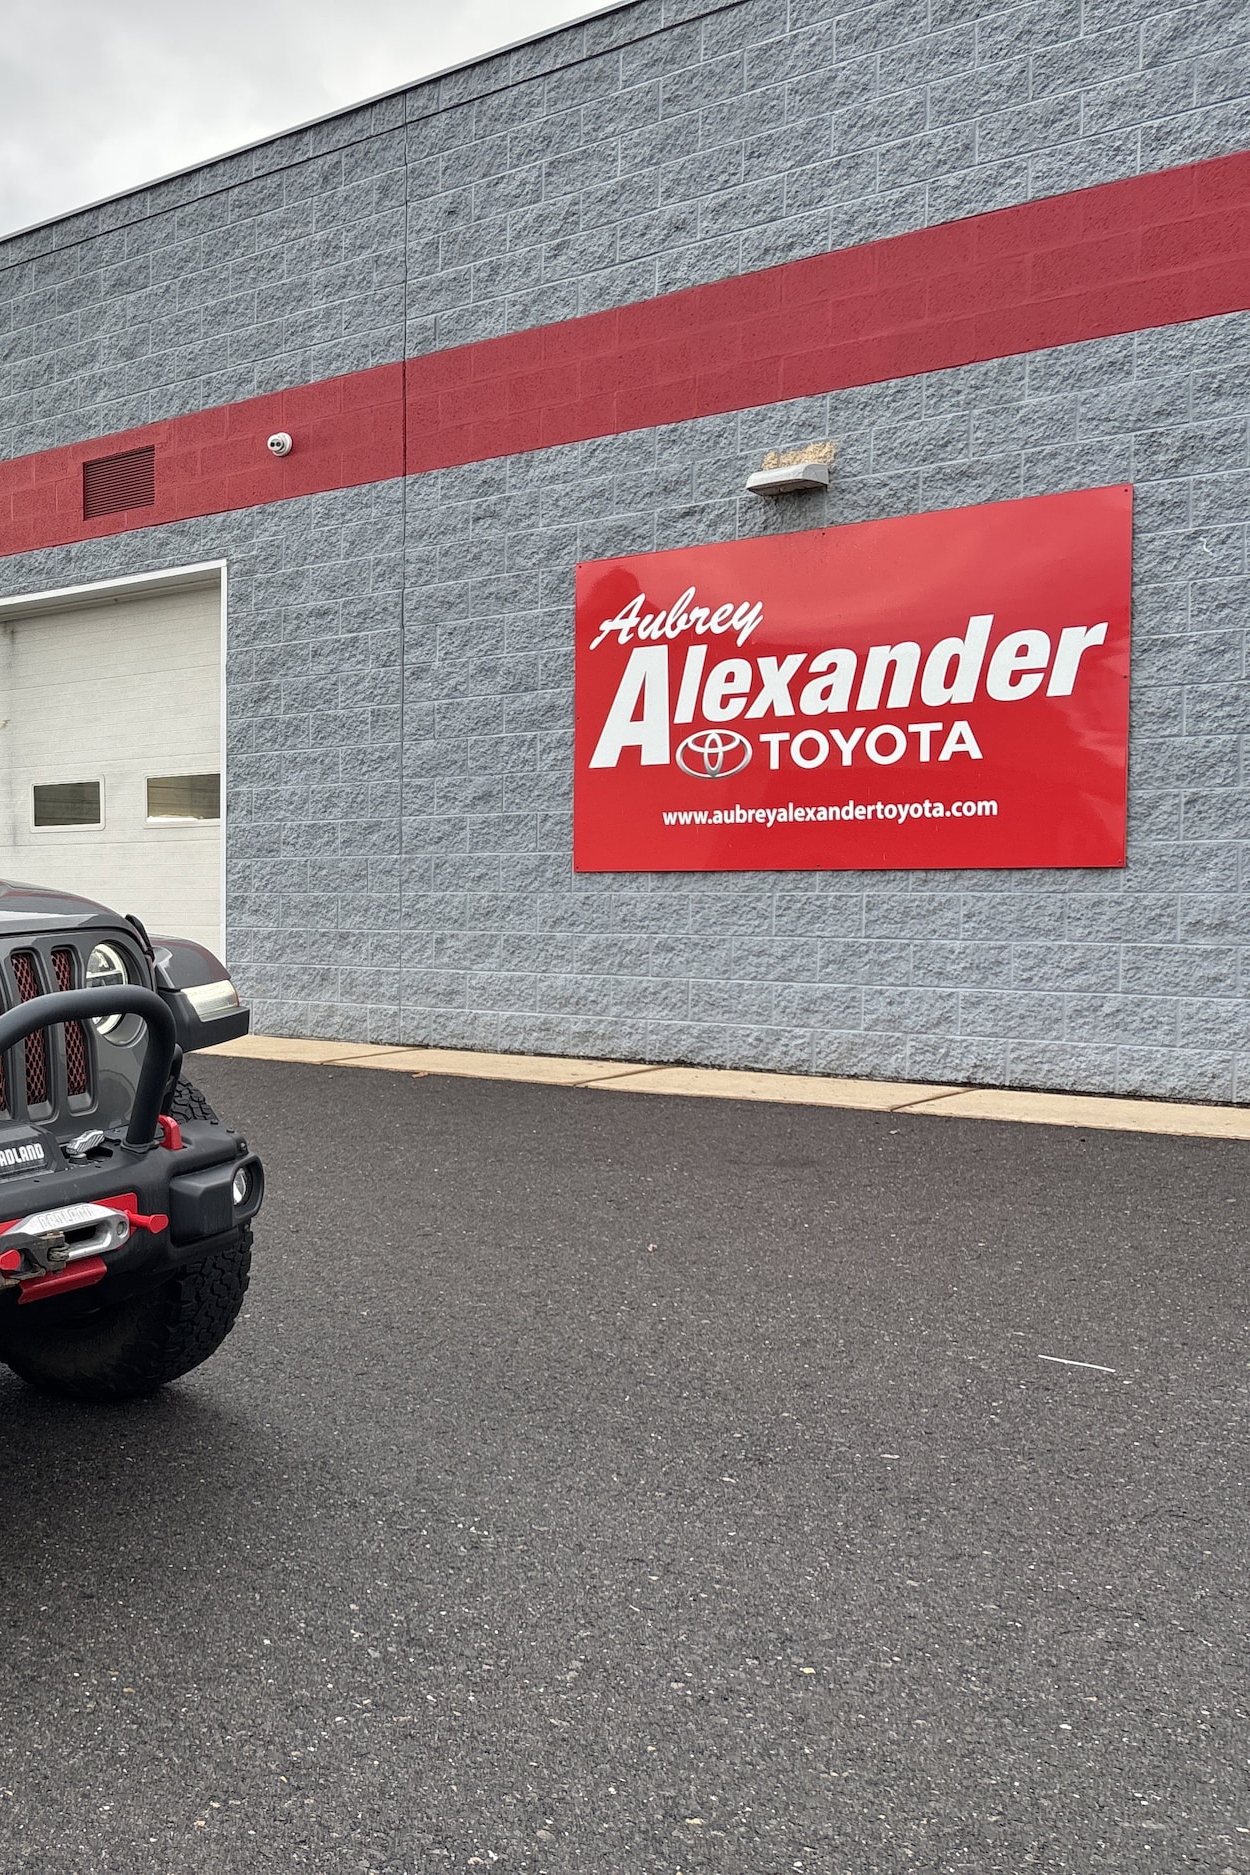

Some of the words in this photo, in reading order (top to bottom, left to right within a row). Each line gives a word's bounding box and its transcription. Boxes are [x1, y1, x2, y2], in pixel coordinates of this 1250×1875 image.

[589, 585, 764, 650] Aubrey
[588, 614, 1109, 769] Alexander
[759, 721, 983, 771] TOYOTA
[662, 799, 998, 828] www.aubreyalexandertoyota.com
